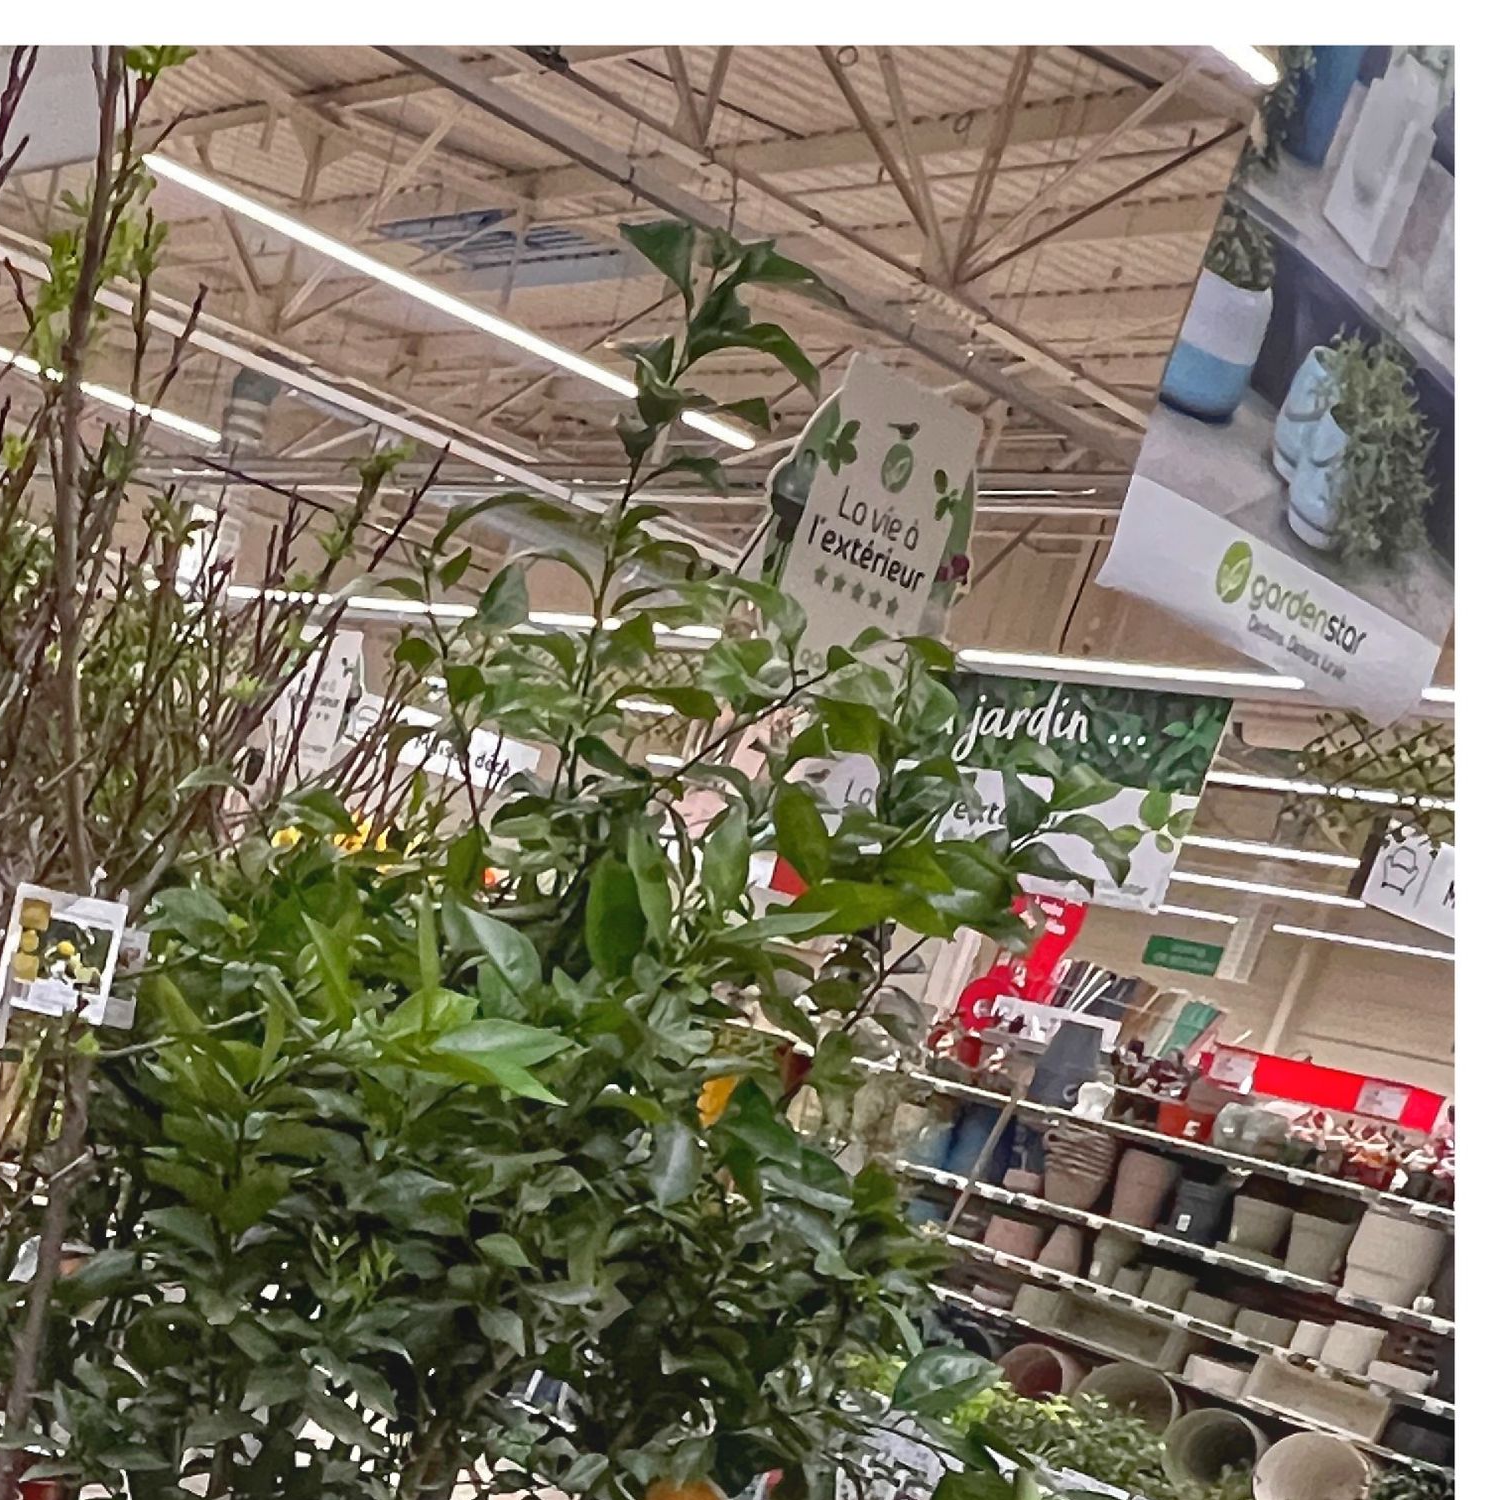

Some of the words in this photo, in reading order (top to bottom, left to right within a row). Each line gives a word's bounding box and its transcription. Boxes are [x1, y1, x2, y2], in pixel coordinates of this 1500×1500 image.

[807, 513, 927, 593] l'extérieur
[838, 485, 868, 527] La
[871, 505, 904, 542] vie
[903, 518, 920, 551] à
[1248, 574, 1368, 655] gardenstar
[950, 682, 1089, 762] jardin
